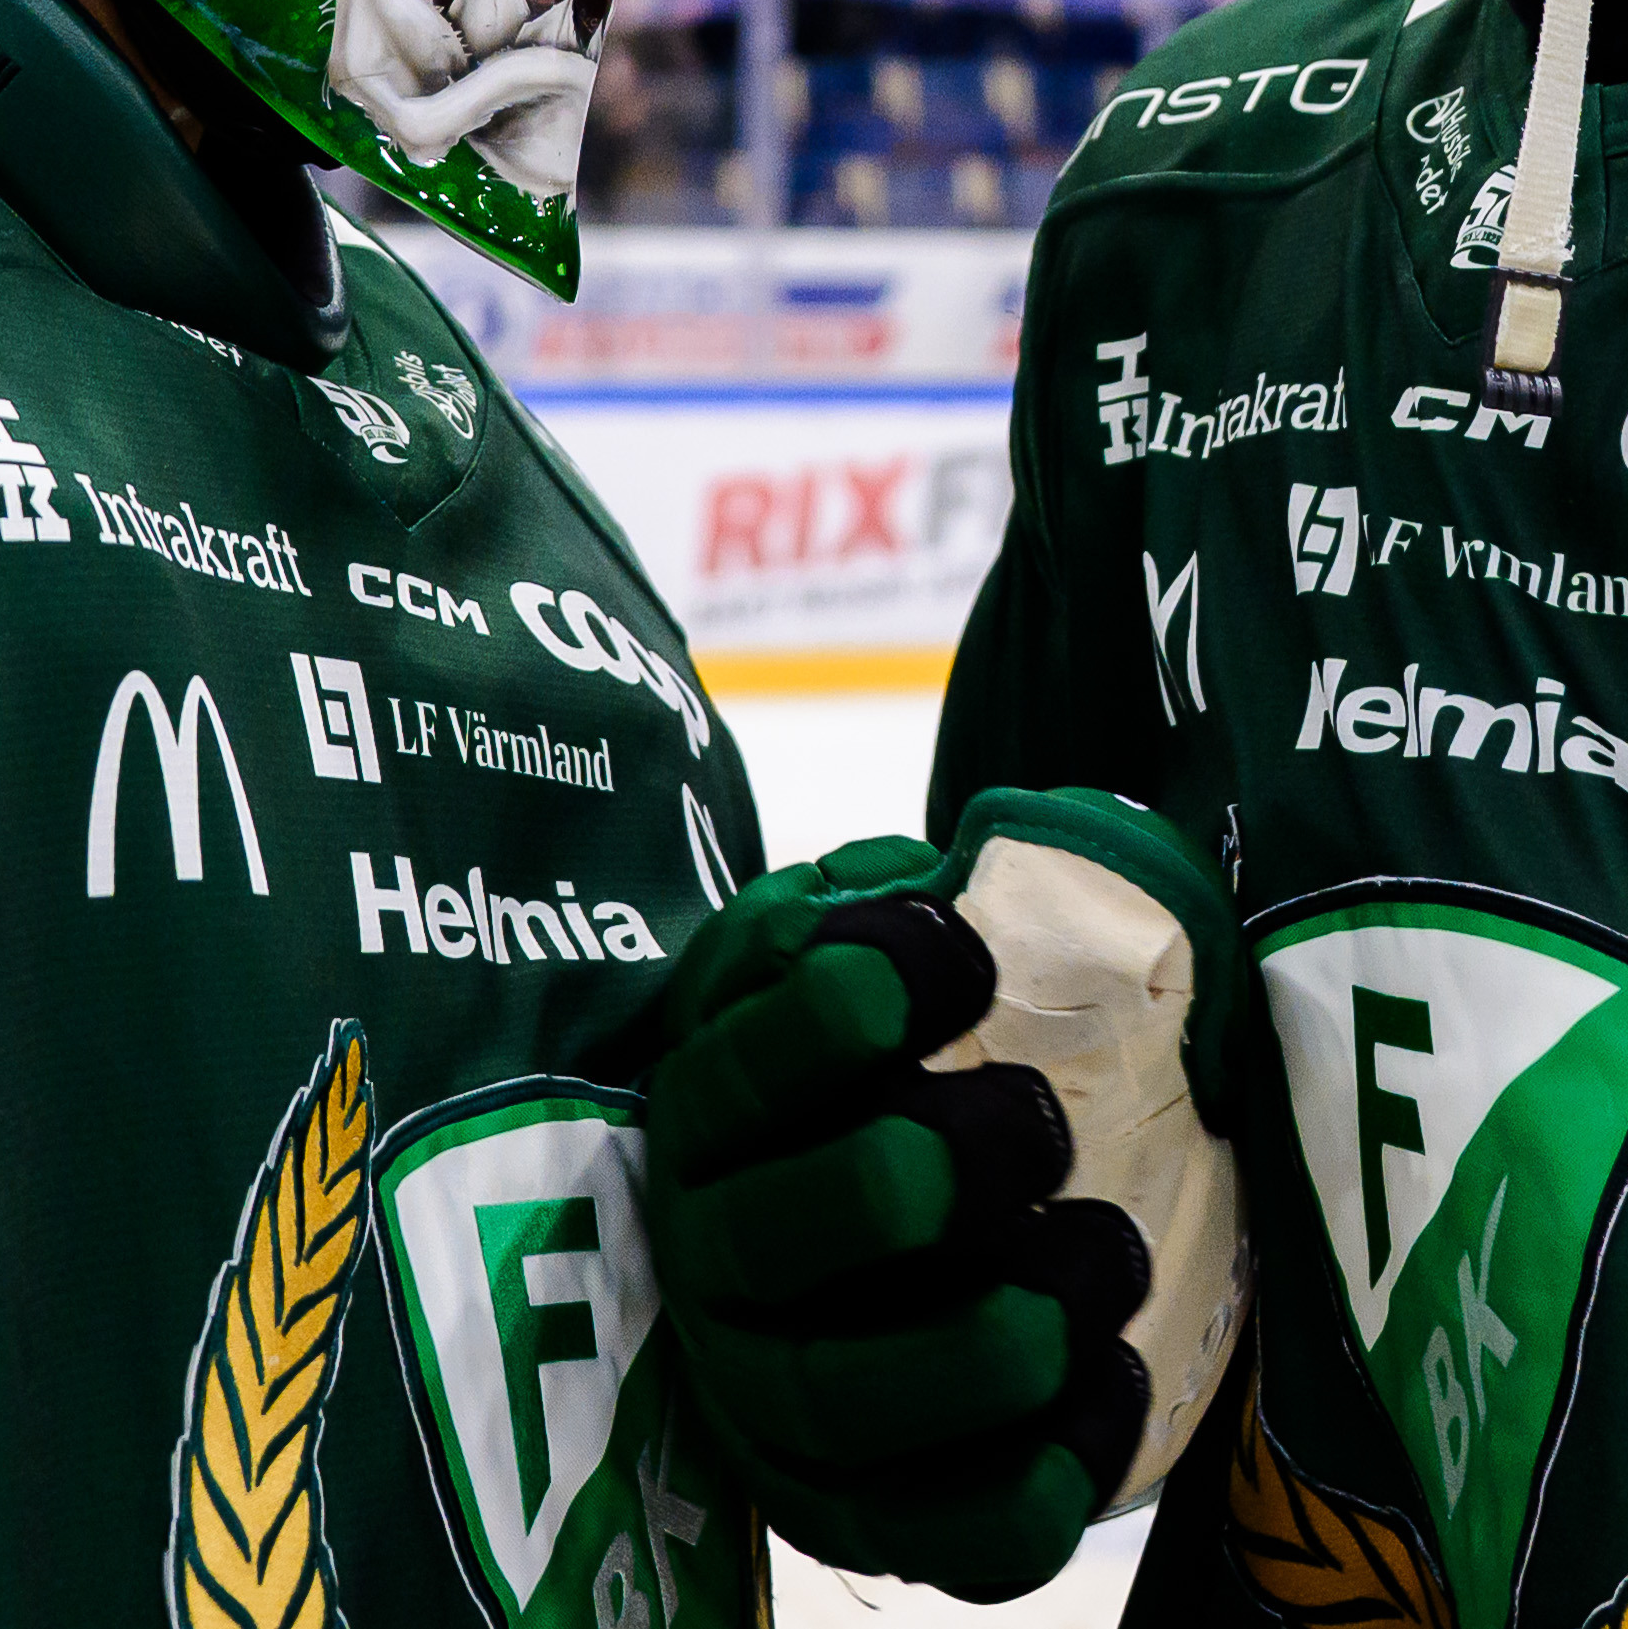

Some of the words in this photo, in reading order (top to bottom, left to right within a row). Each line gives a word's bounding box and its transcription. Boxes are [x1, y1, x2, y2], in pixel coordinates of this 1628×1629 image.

[74, 472, 313, 598] Infrakraft
[347, 562, 491, 636] CCM
[387, 696, 437, 758] LF
[446, 704, 615, 793] Värmland
[349, 851, 667, 965] Helmia
